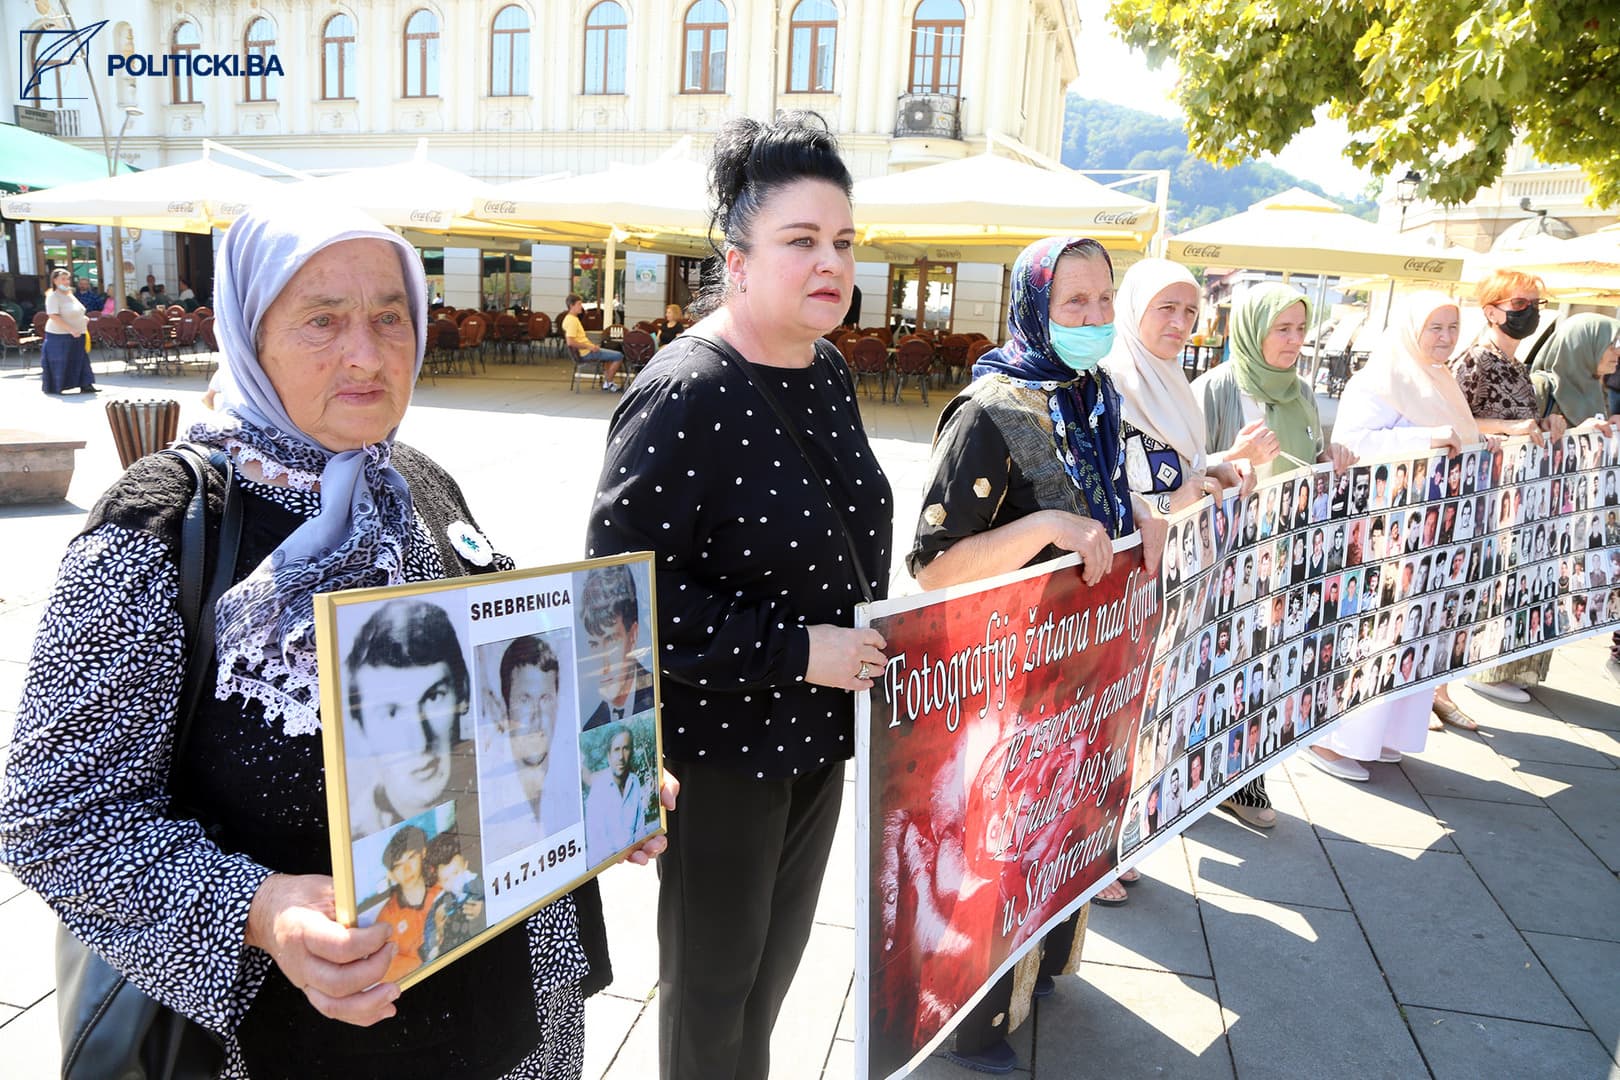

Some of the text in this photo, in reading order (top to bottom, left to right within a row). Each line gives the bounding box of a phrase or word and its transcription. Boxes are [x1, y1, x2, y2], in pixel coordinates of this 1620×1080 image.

[470, 589, 571, 622] SREBRENICA
[883, 566, 1158, 733] Fotografije žrtava nad kojim
[991, 637, 1156, 801] je izvršen genocid
[491, 839, 582, 897] 11.7.1995.
[1001, 798, 1124, 937] u Srebrenici
[1012, 767, 1064, 863] jula
